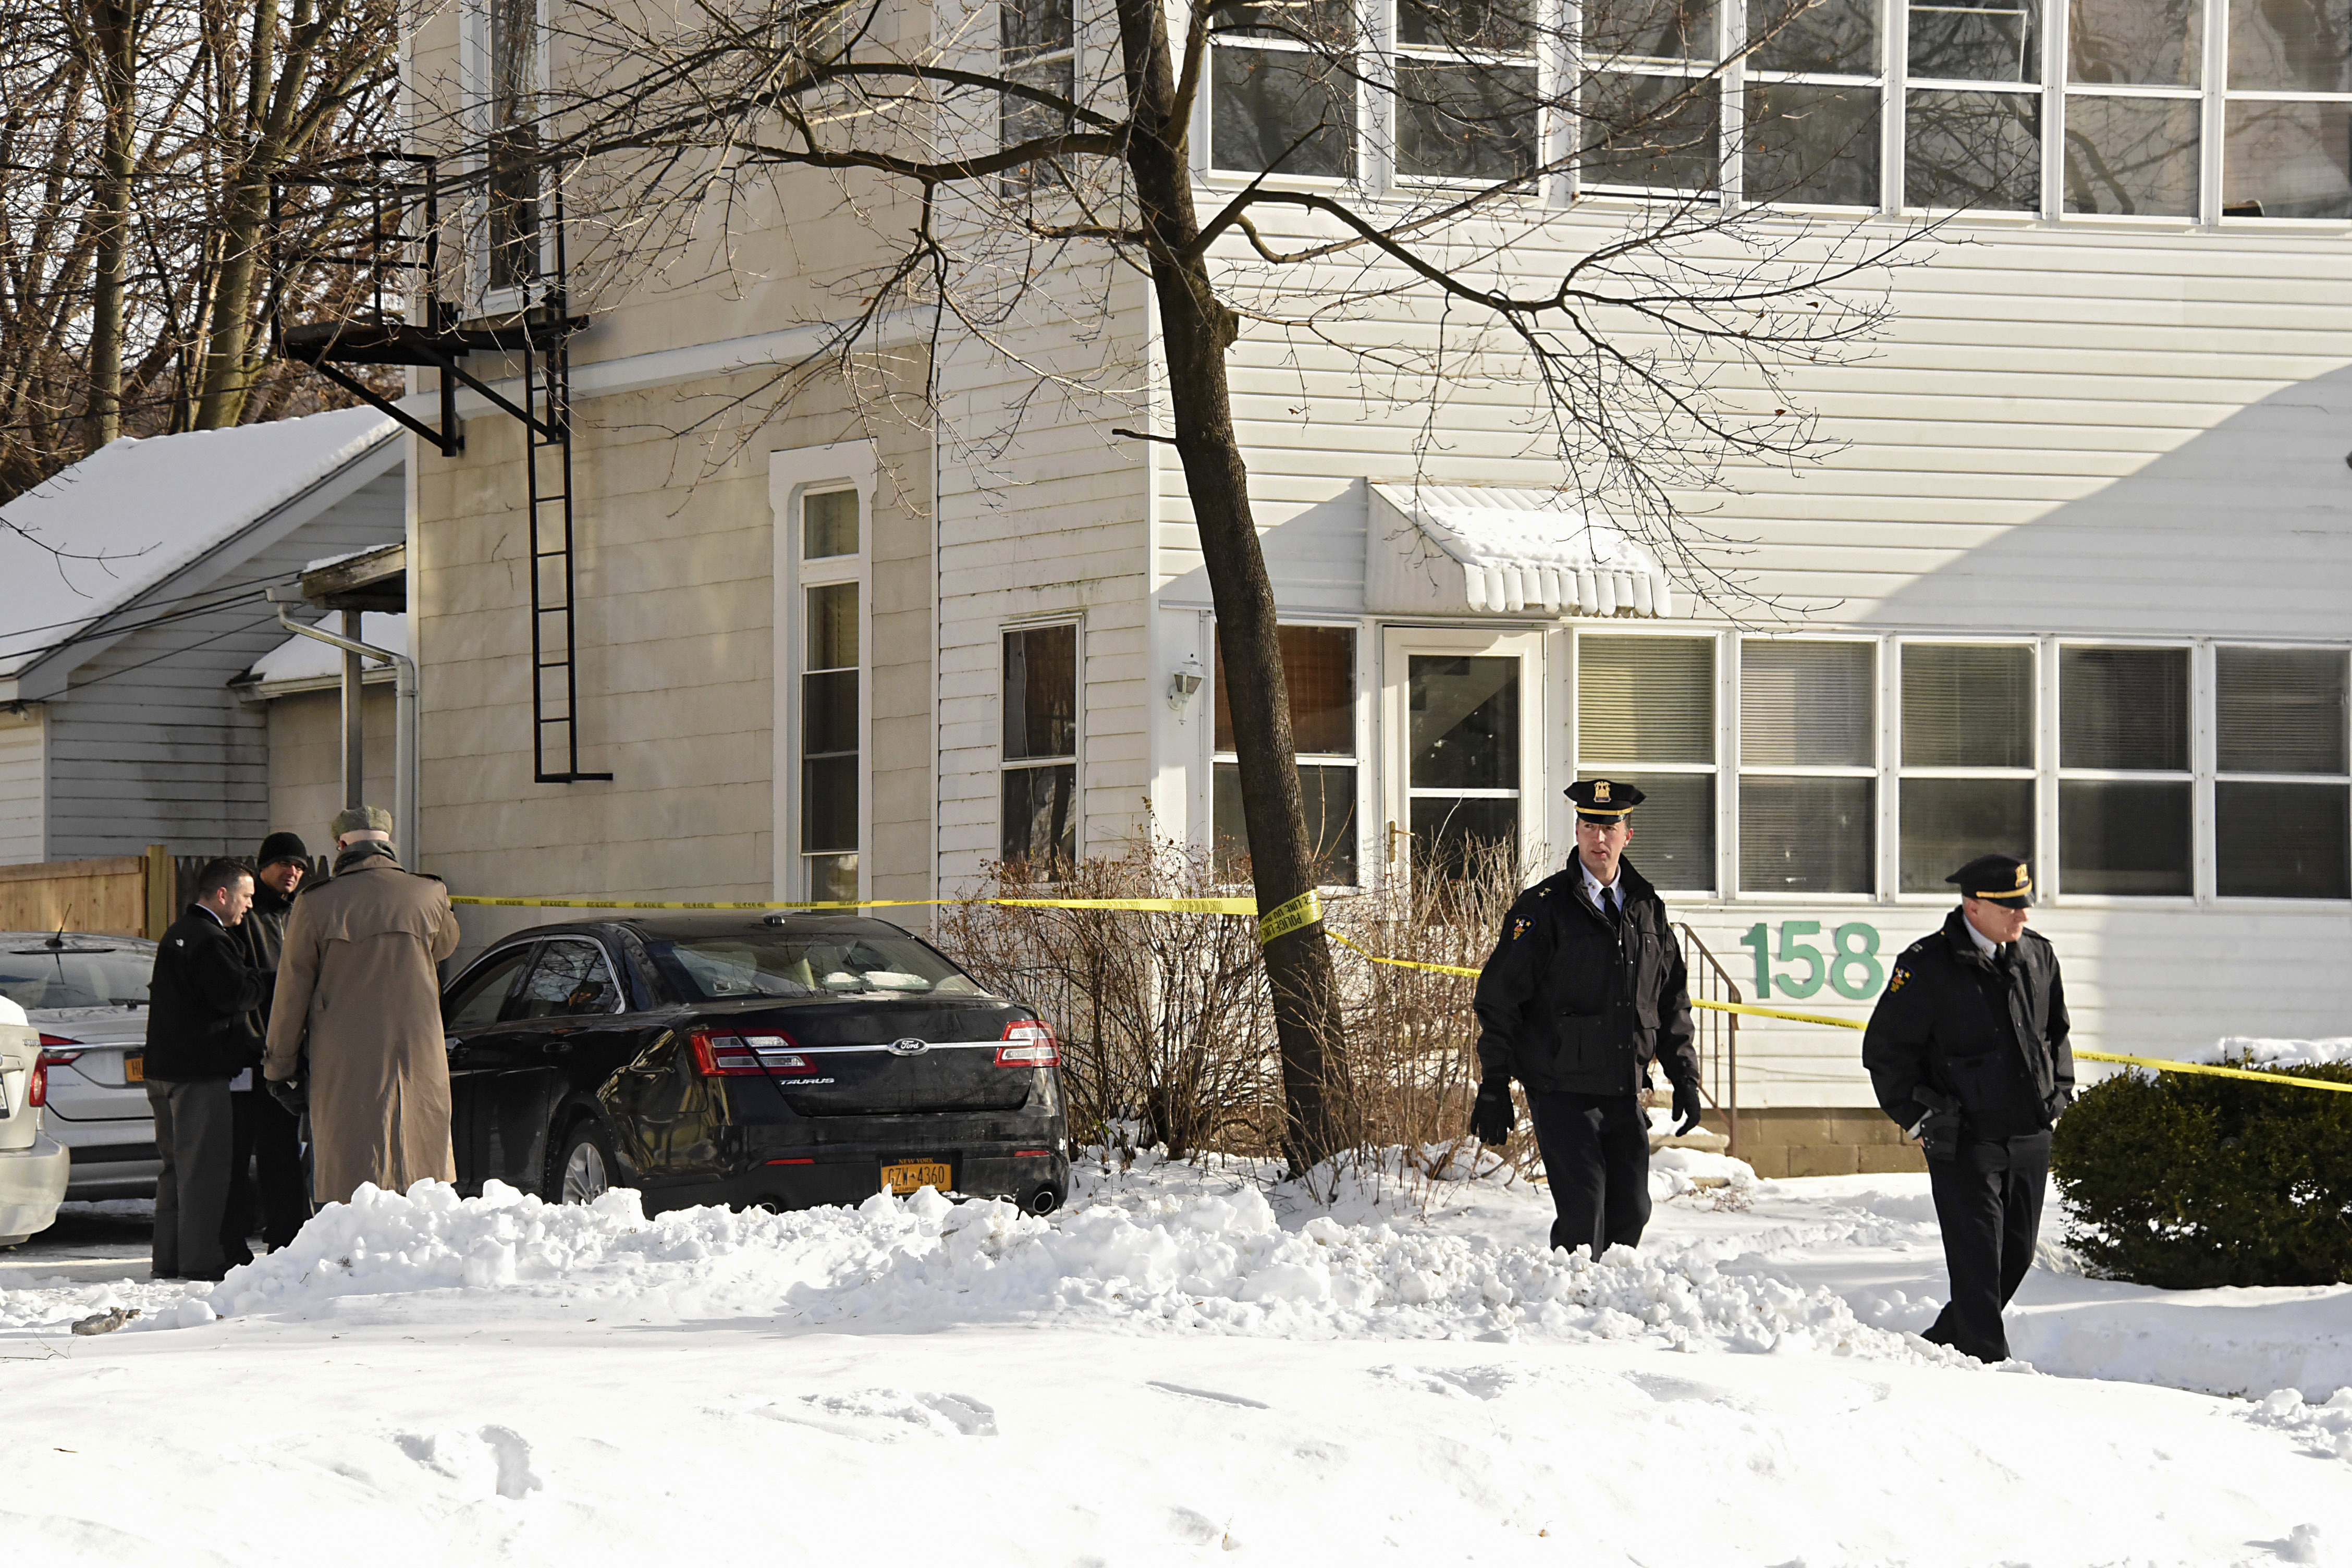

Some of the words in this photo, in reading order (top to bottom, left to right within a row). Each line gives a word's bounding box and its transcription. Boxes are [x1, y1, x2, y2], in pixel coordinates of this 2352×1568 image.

[1262, 924, 1275, 939] LINE
[1275, 913, 1302, 932] POLICE
[1740, 921, 1884, 1000] 158
[901, 1040, 919, 1049] Ford
[888, 1168, 909, 1186] GZW
[917, 1166, 945, 1185] 4360
